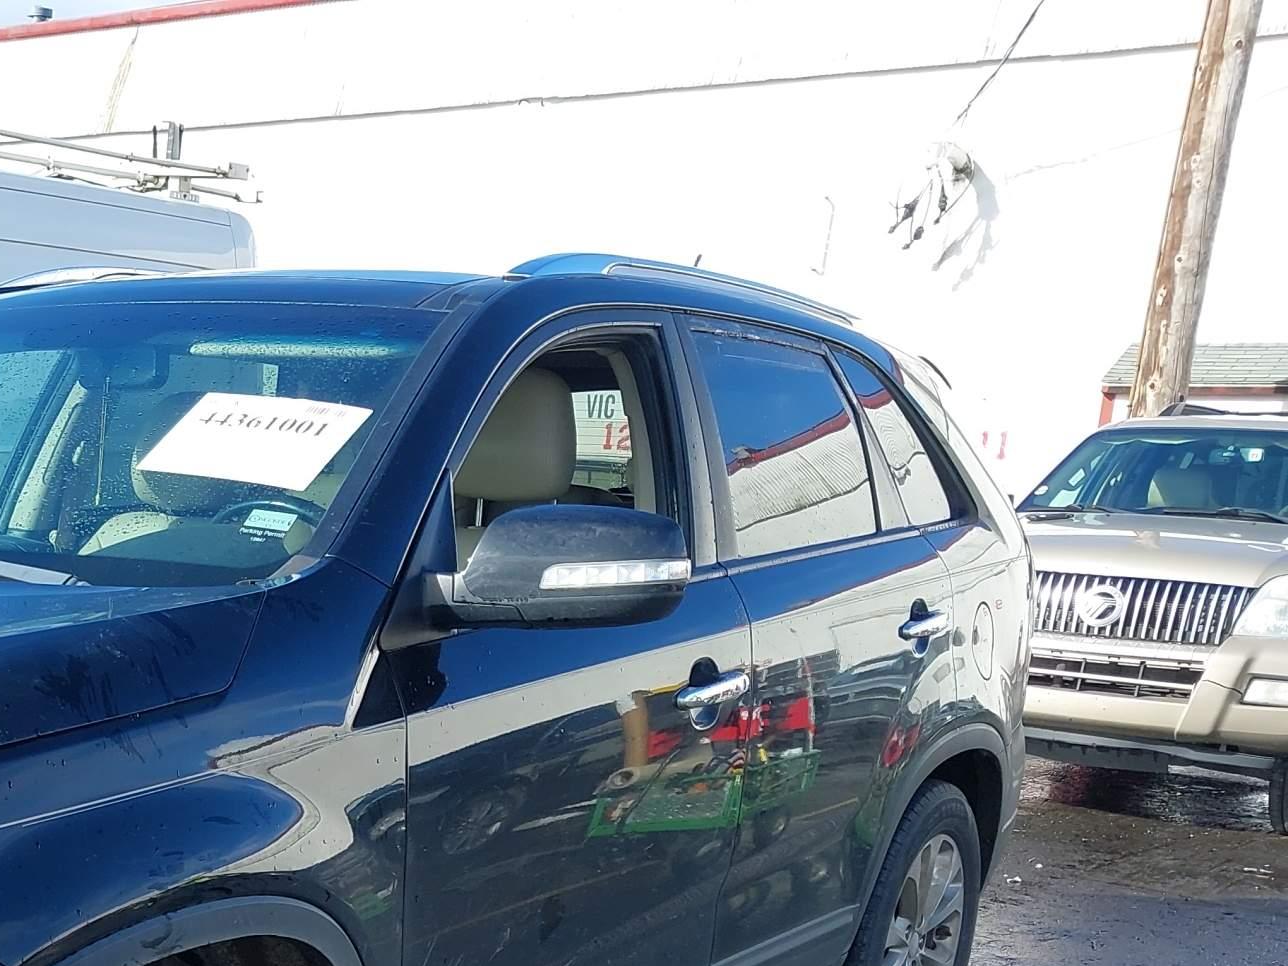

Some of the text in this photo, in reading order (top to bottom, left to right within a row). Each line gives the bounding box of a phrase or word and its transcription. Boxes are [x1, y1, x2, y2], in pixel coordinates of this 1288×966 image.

[199, 411, 329, 437] 44361001
[239, 526, 286, 539] Parking Permit
